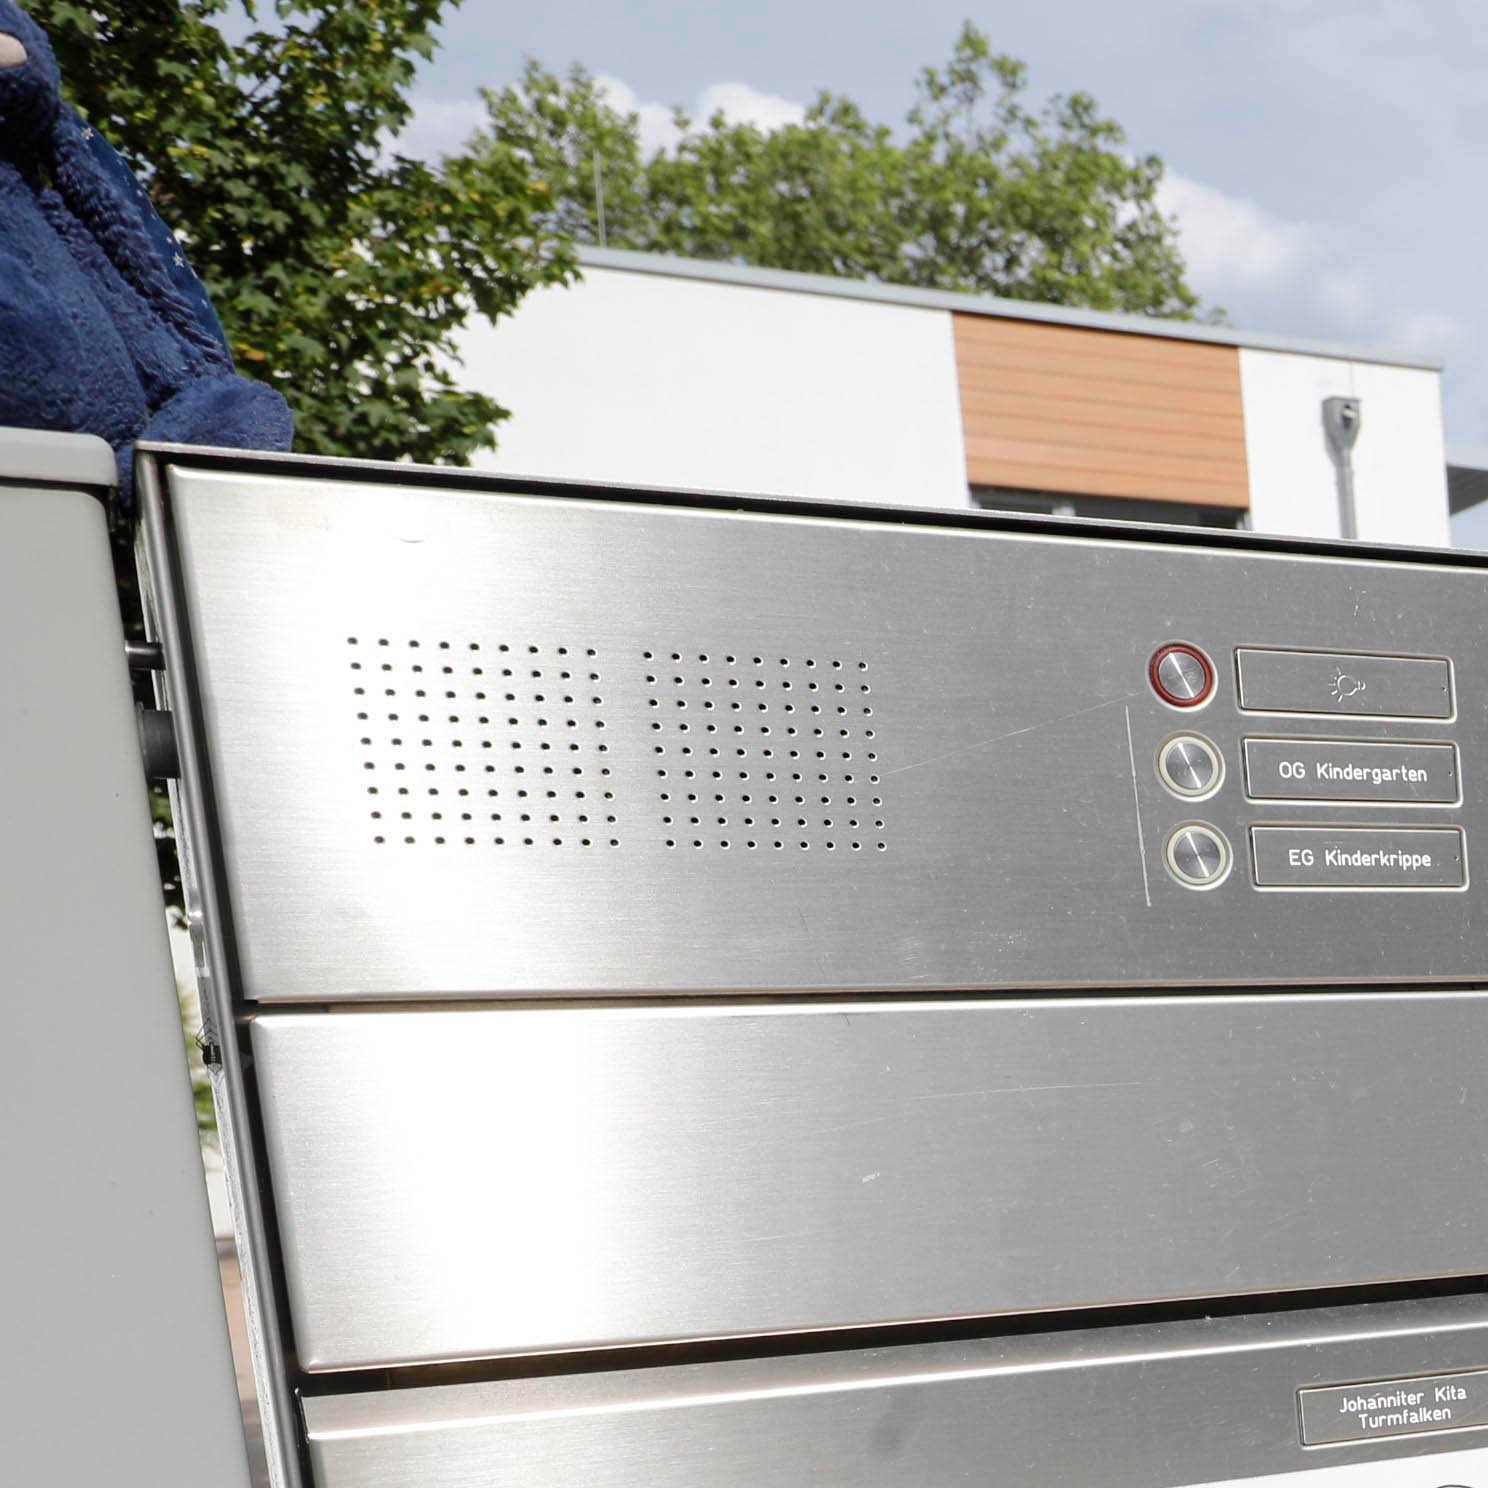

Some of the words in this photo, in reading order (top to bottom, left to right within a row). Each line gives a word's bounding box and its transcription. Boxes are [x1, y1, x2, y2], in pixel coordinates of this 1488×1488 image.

[1278, 762, 1306, 779] OG
[1316, 762, 1428, 784] Kindergarten
[1288, 849, 1314, 867] EG
[1325, 850, 1432, 871] Kinderkrippe
[1339, 1390, 1425, 1414] Johanniter
[1434, 1384, 1467, 1402] Kita
[1358, 1406, 1452, 1430] Turmfalken
